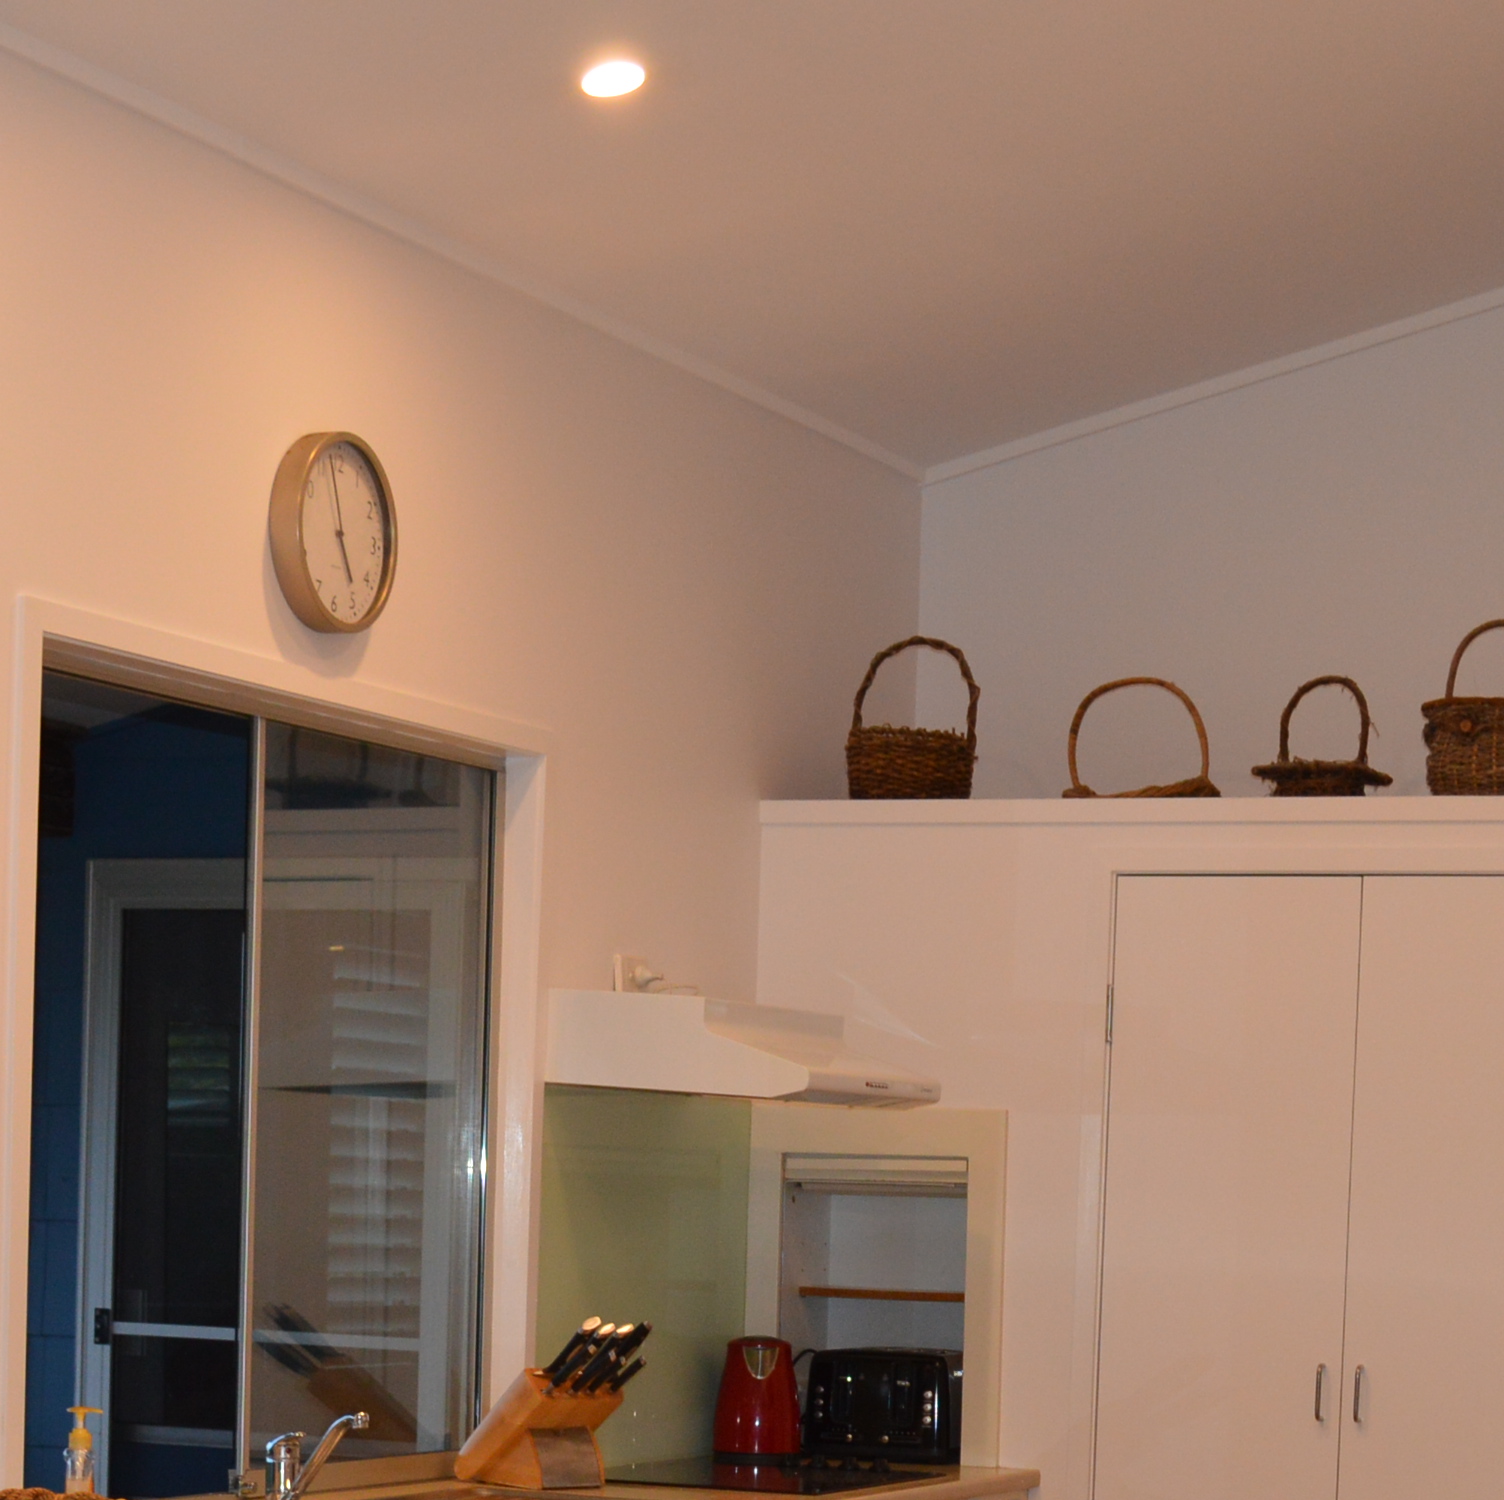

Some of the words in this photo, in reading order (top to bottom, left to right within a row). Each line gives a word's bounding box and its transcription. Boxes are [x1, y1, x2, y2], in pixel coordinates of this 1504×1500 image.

[365, 500, 375, 521] 2
[369, 536, 378, 557] 3
[362, 570, 371, 589] 4
[330, 594, 339, 613] 6
[348, 590, 357, 611] 5
